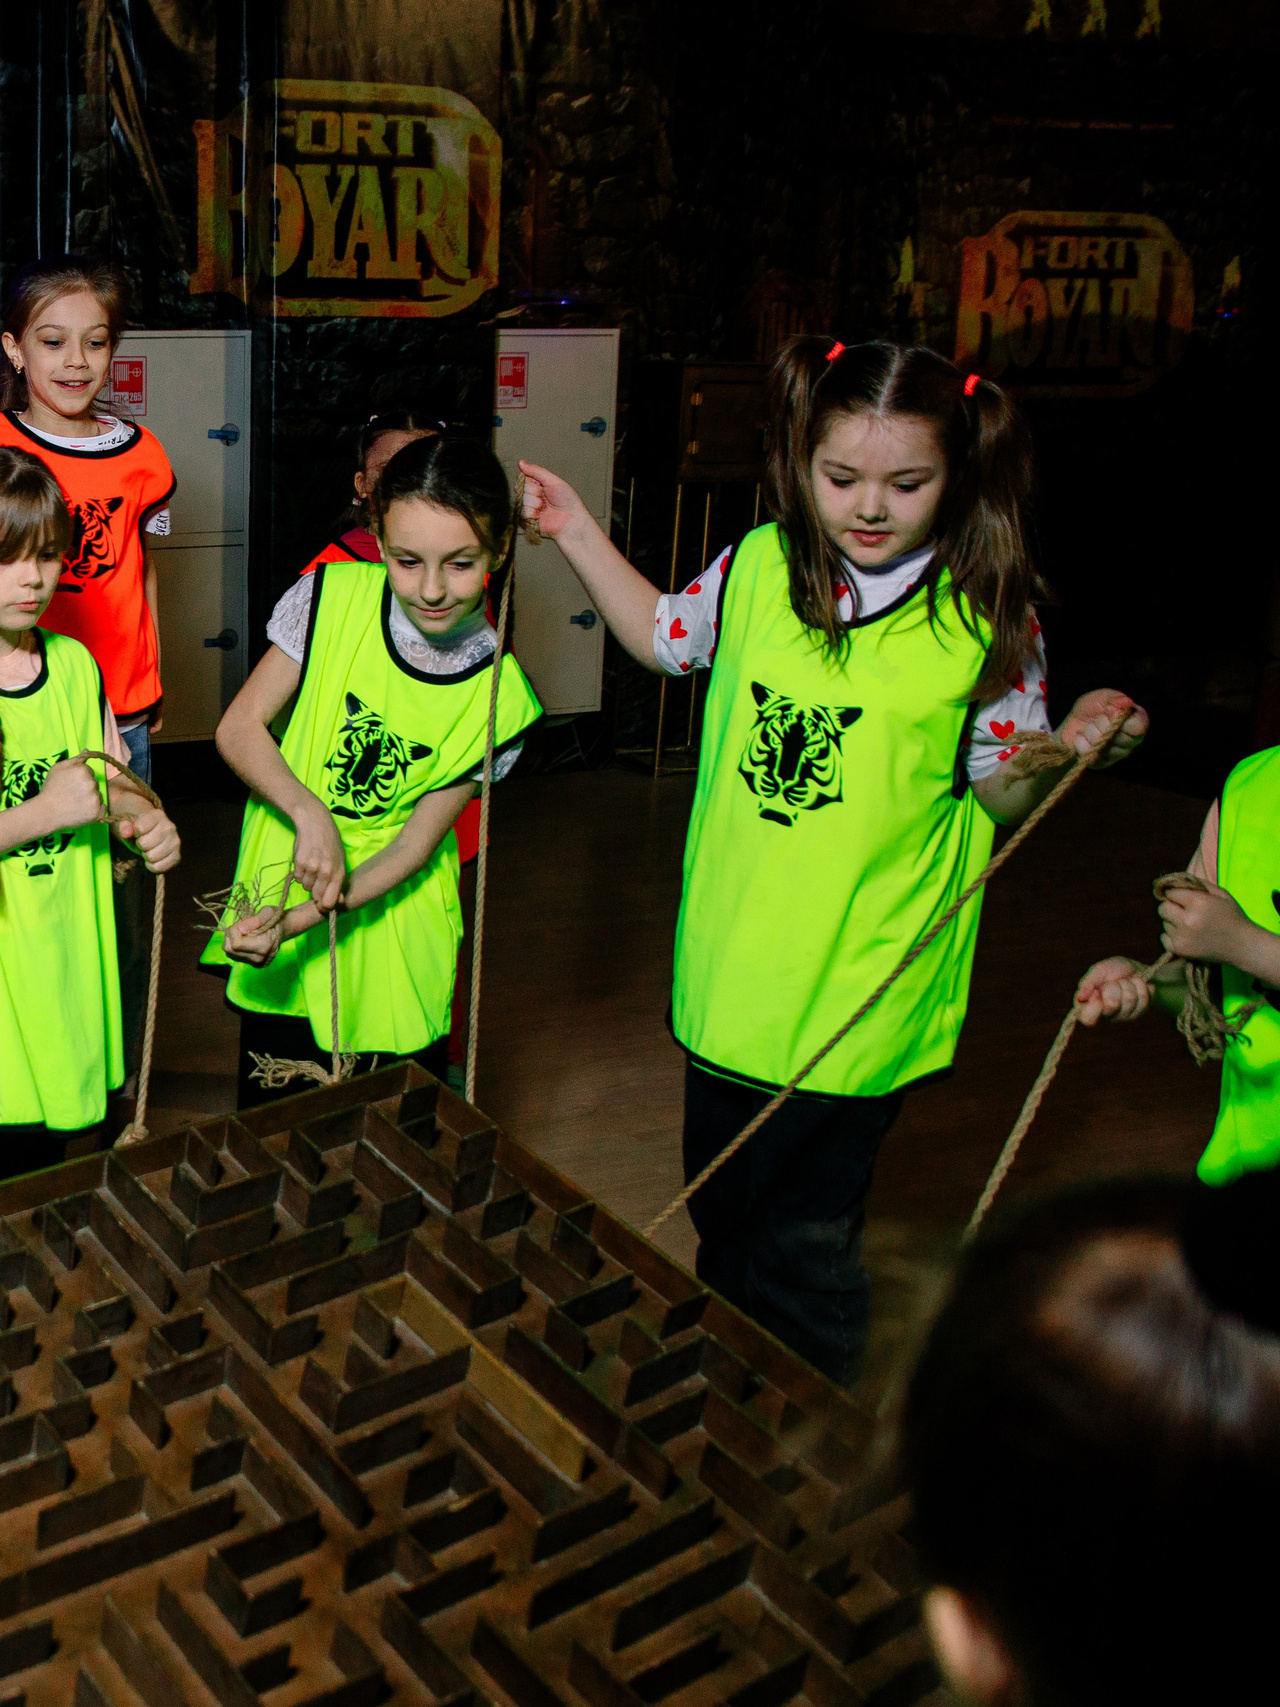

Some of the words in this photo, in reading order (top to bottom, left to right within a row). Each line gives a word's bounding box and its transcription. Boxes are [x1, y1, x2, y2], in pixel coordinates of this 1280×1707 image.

[265, 109, 427, 157] FORT
[188, 118, 503, 296] BOYARD
[1020, 236, 1136, 270] FORT
[953, 237, 1195, 380] BOYARD
